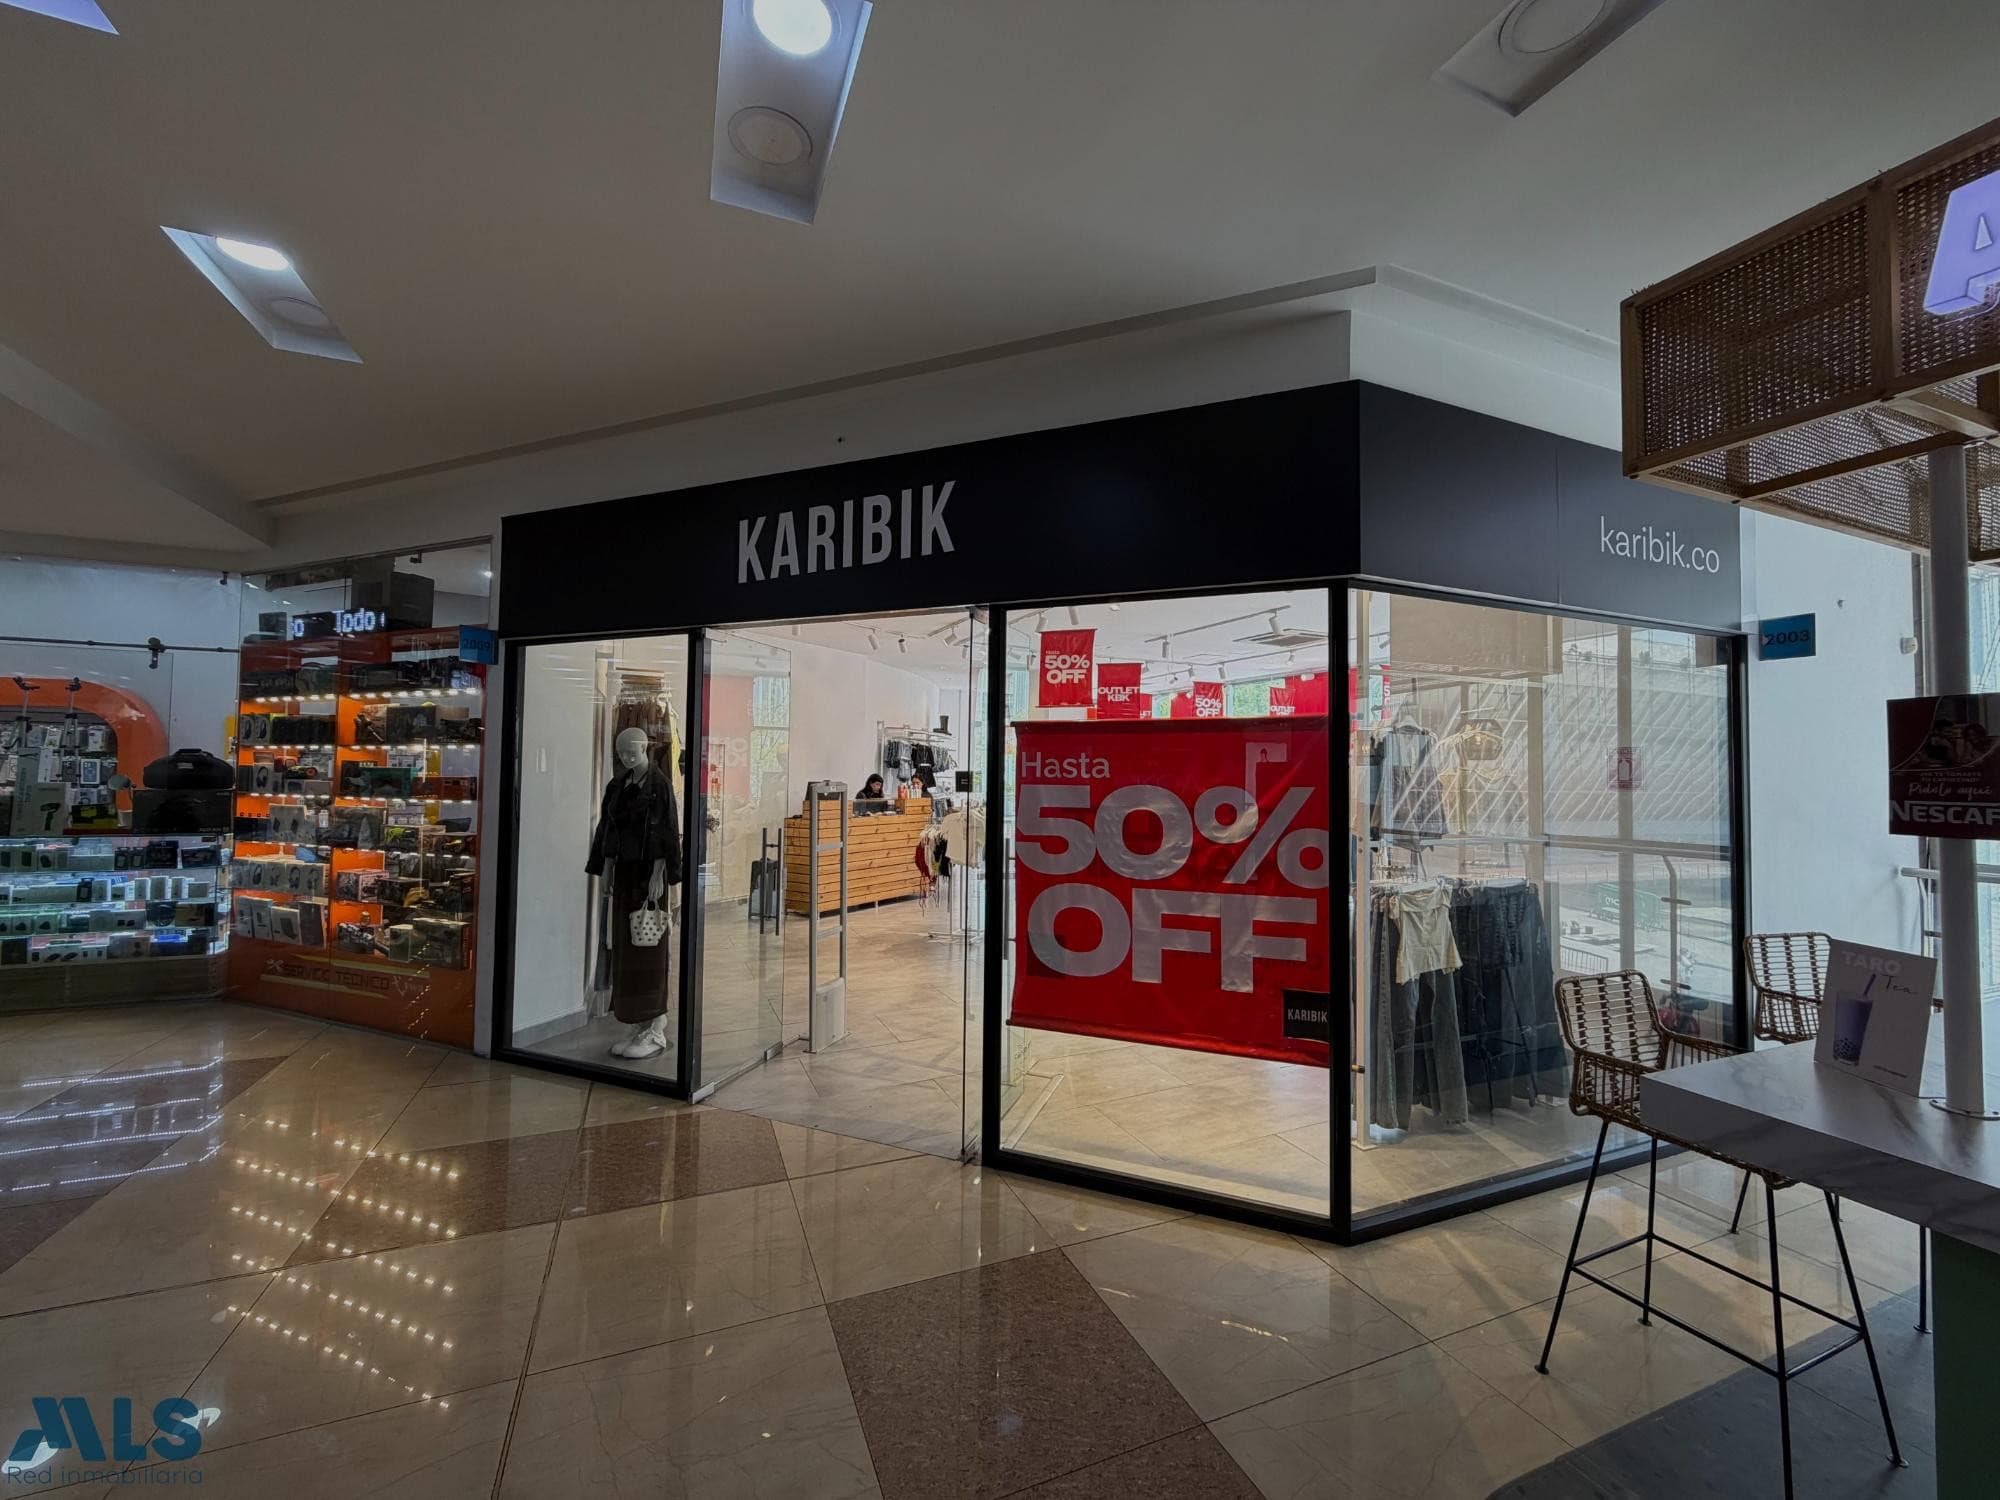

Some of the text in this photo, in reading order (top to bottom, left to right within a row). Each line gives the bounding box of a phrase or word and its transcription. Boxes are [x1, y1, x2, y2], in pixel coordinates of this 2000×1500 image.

[738, 480, 958, 584] KARIBIK
[1600, 515, 1721, 575] karibik.co
[335, 608, 376, 633] Todo
[1764, 630, 1809, 646] 2003
[1045, 655, 1090, 669] 50%
[1046, 669, 1087, 684] OFF
[1098, 686, 1140, 695] OUTLET
[1107, 694, 1130, 702] KBK
[1195, 697, 1221, 709] 50%
[1196, 707, 1220, 717] OFF
[1021, 751, 1110, 779] Hasta
[1890, 800, 2000, 825] NESCAF
[1015, 785, 1329, 889] 50%
[1027, 883, 1318, 994] OFF
[1841, 951, 1902, 974] TARO
[1881, 974, 1918, 994] Tea
[1287, 1008, 1328, 1023] KARIBIK
